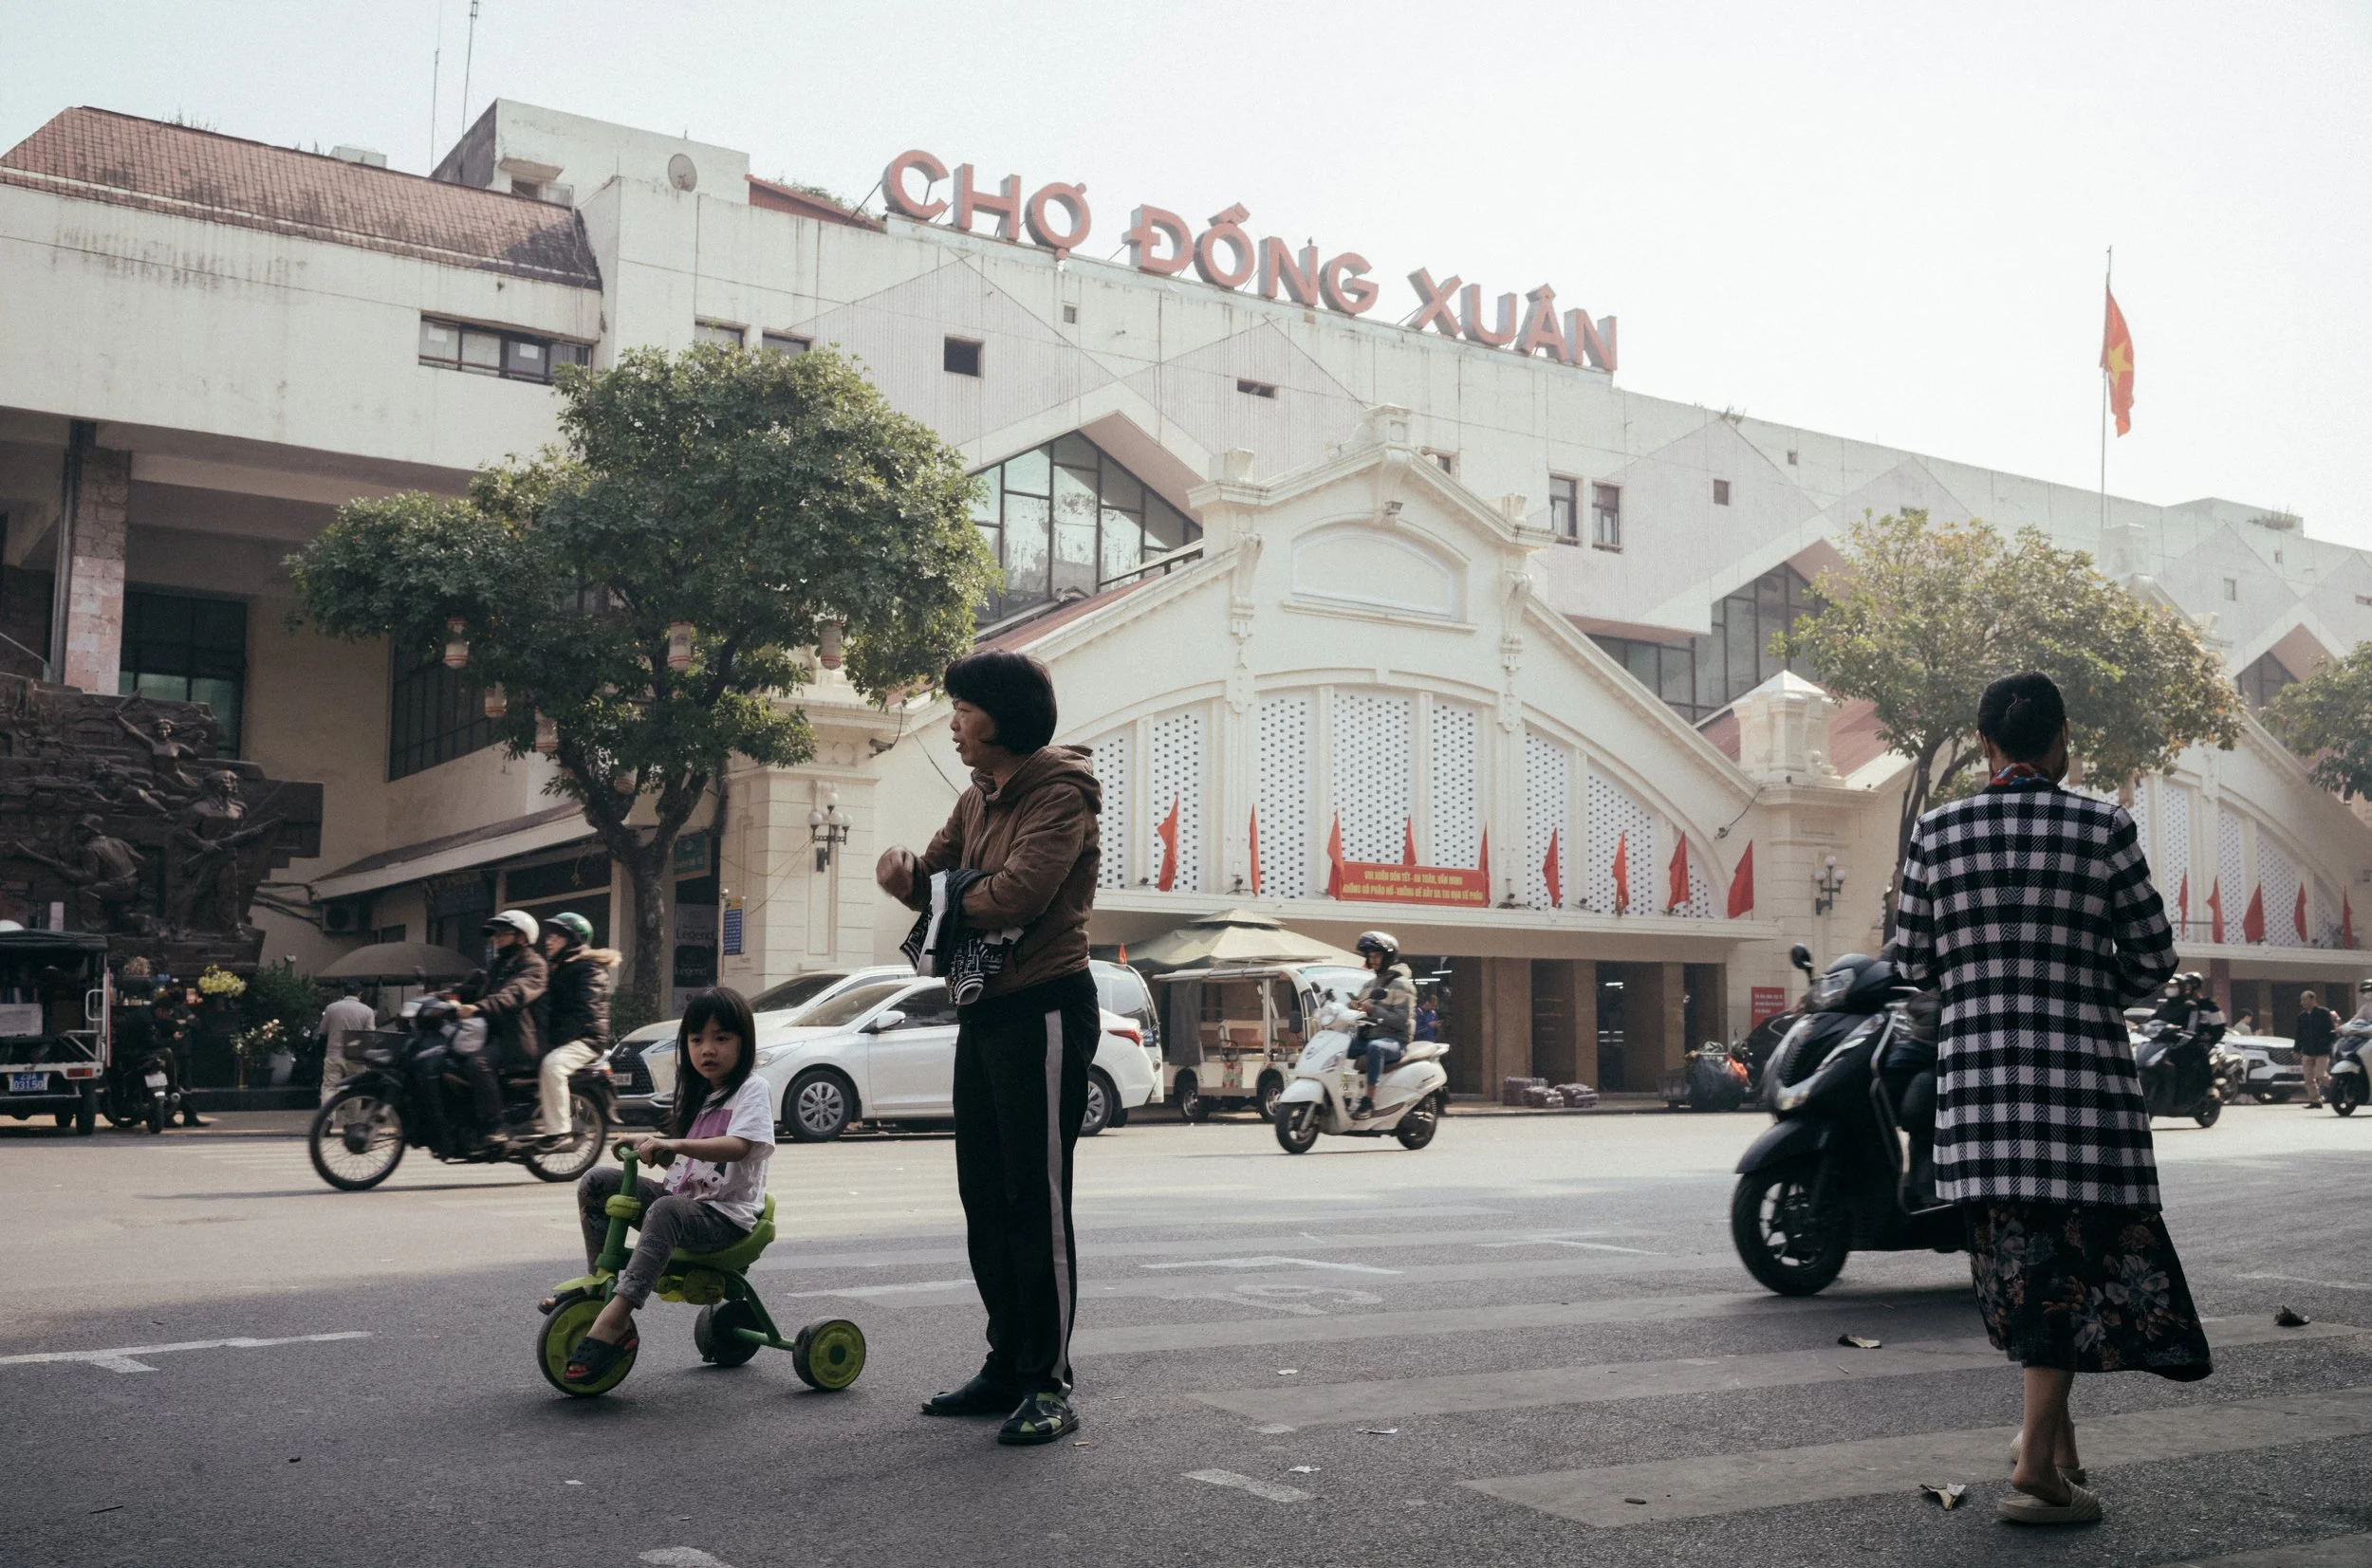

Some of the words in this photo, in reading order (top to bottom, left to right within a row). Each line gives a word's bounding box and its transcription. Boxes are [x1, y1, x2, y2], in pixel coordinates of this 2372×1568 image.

[881, 149, 1091, 262] CHỢ
[1406, 266, 1618, 372] XUÂN
[676, 929, 714, 941] Legend
